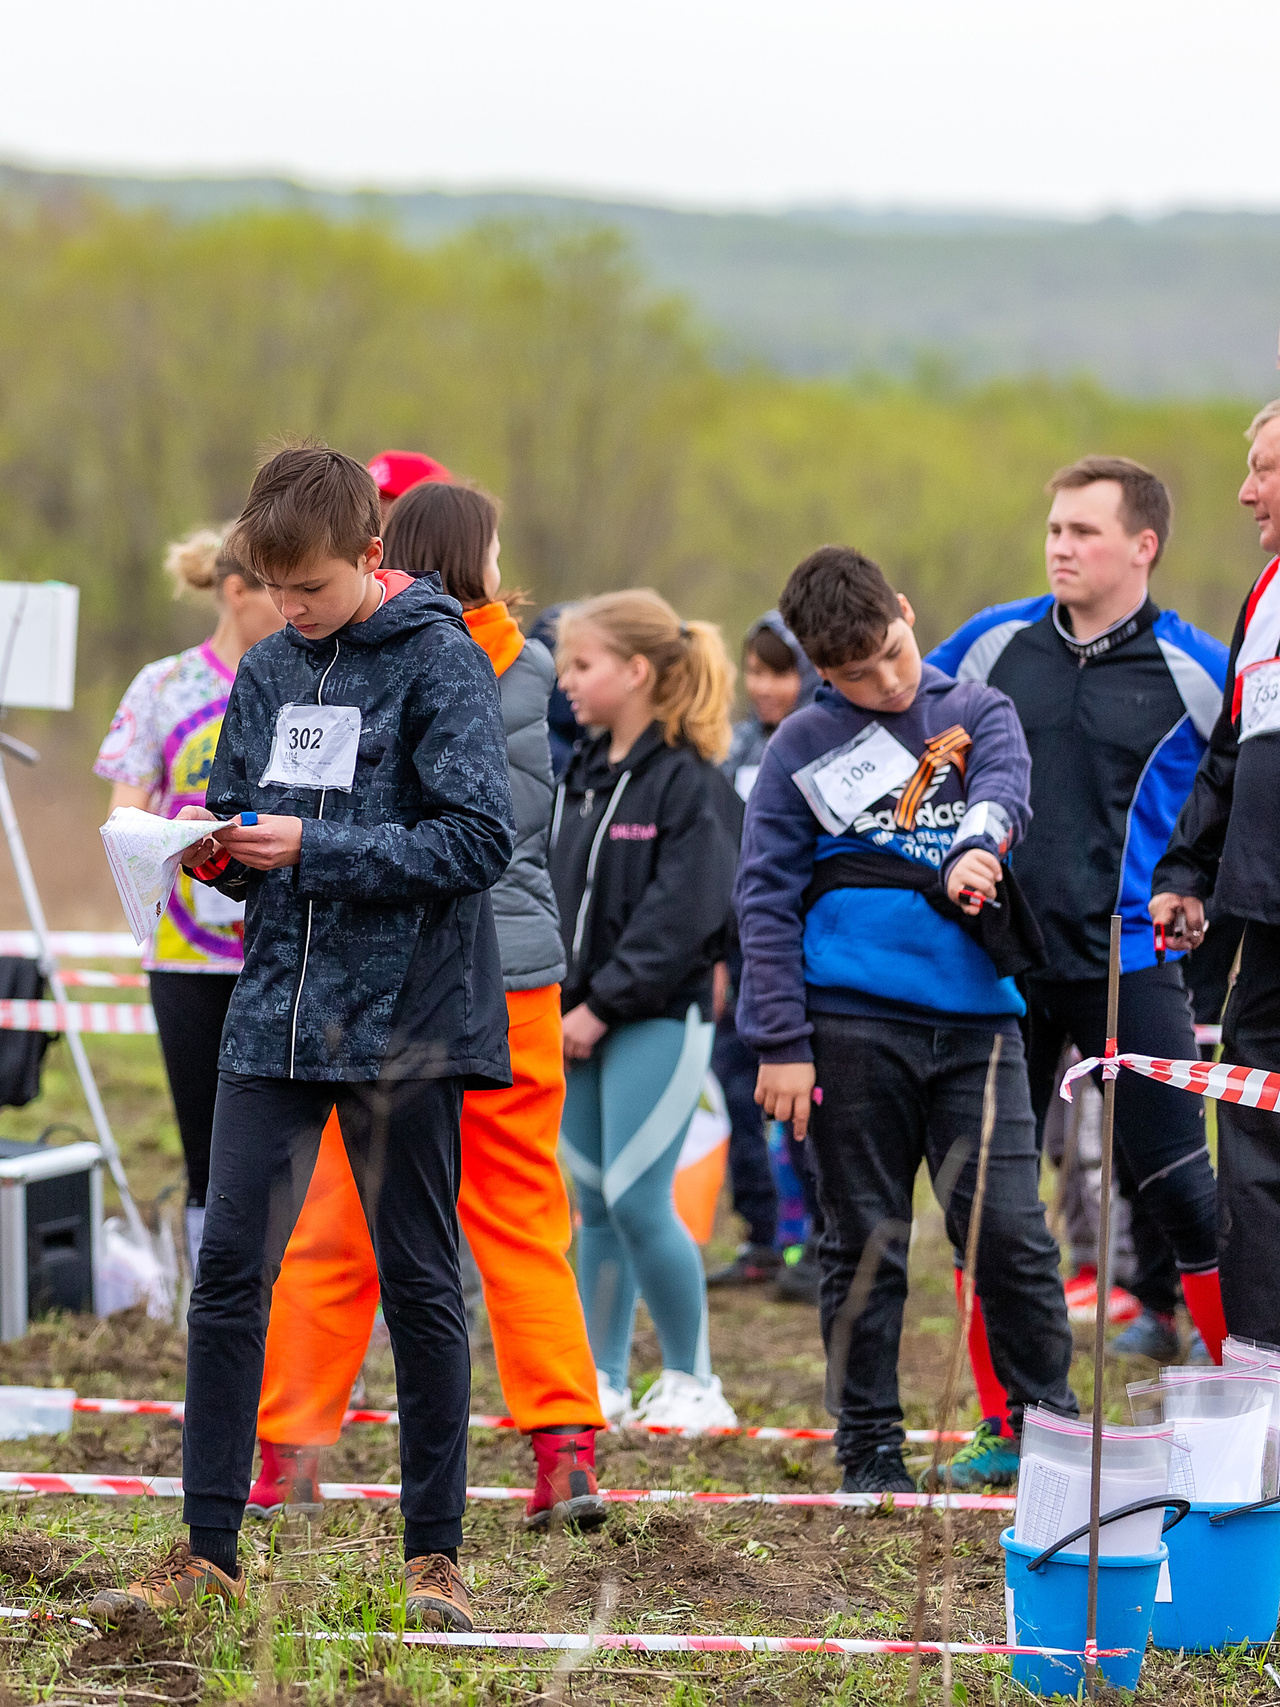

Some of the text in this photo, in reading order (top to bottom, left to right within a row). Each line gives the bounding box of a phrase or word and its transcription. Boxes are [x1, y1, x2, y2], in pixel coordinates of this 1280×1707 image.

[288, 727, 324, 750] 302
[839, 759, 877, 789] 108
[875, 800, 966, 832] adas
